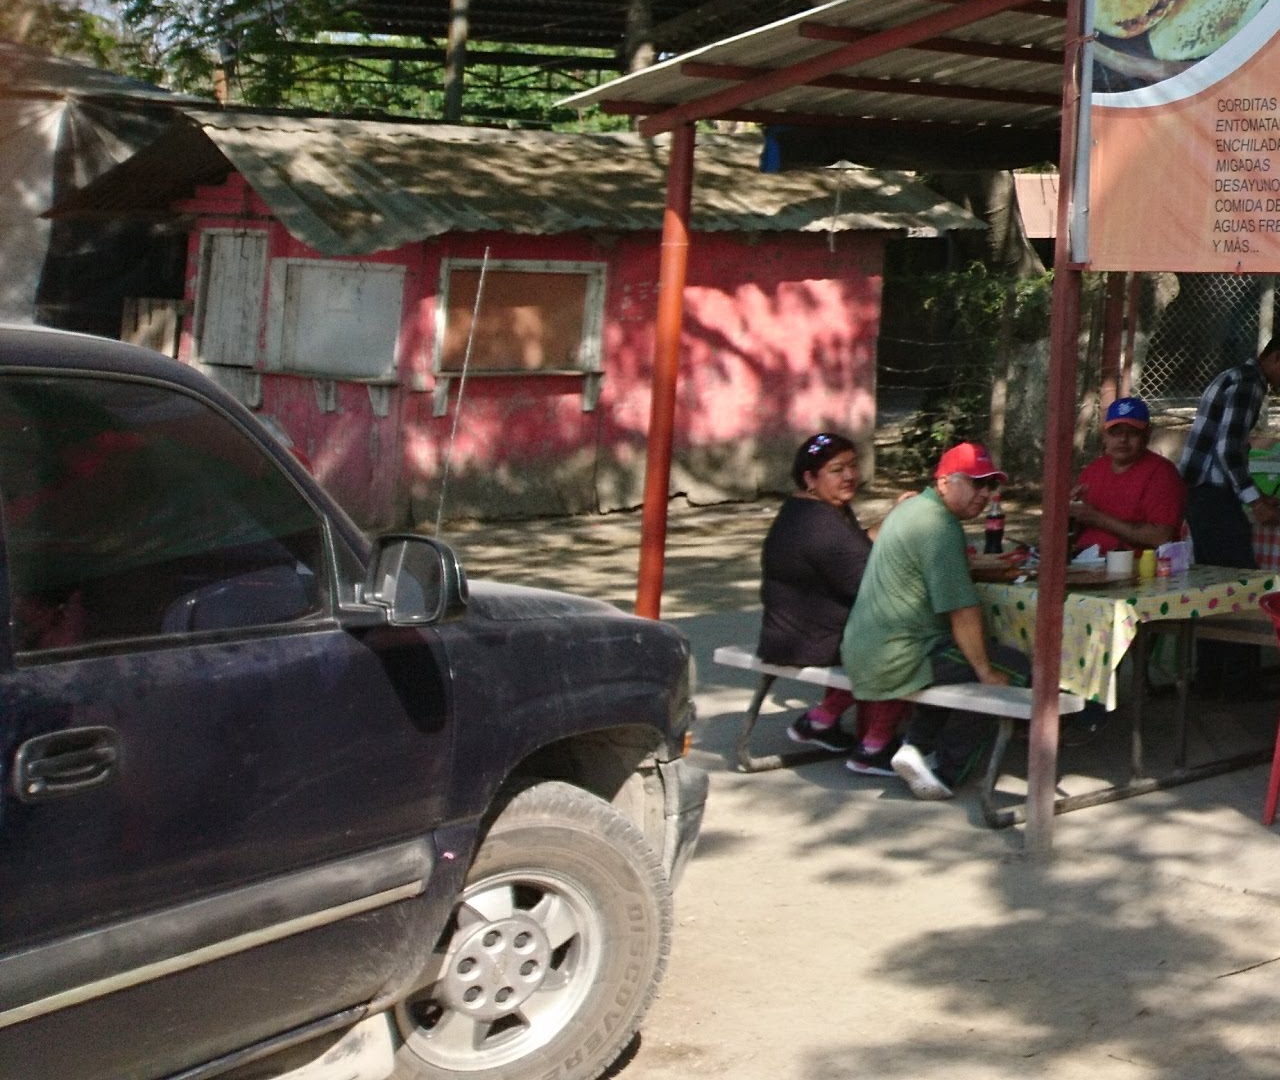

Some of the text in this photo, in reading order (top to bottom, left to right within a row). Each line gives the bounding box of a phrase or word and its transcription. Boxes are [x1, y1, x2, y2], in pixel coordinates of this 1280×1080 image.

[1217, 98, 1277, 112] GORDITAS
[1216, 159, 1271, 172] MIGADAS
[1215, 199, 1263, 213] COMIDA
[1213, 220, 1256, 233] AGUAS
[1212, 240, 1222, 253] Y
